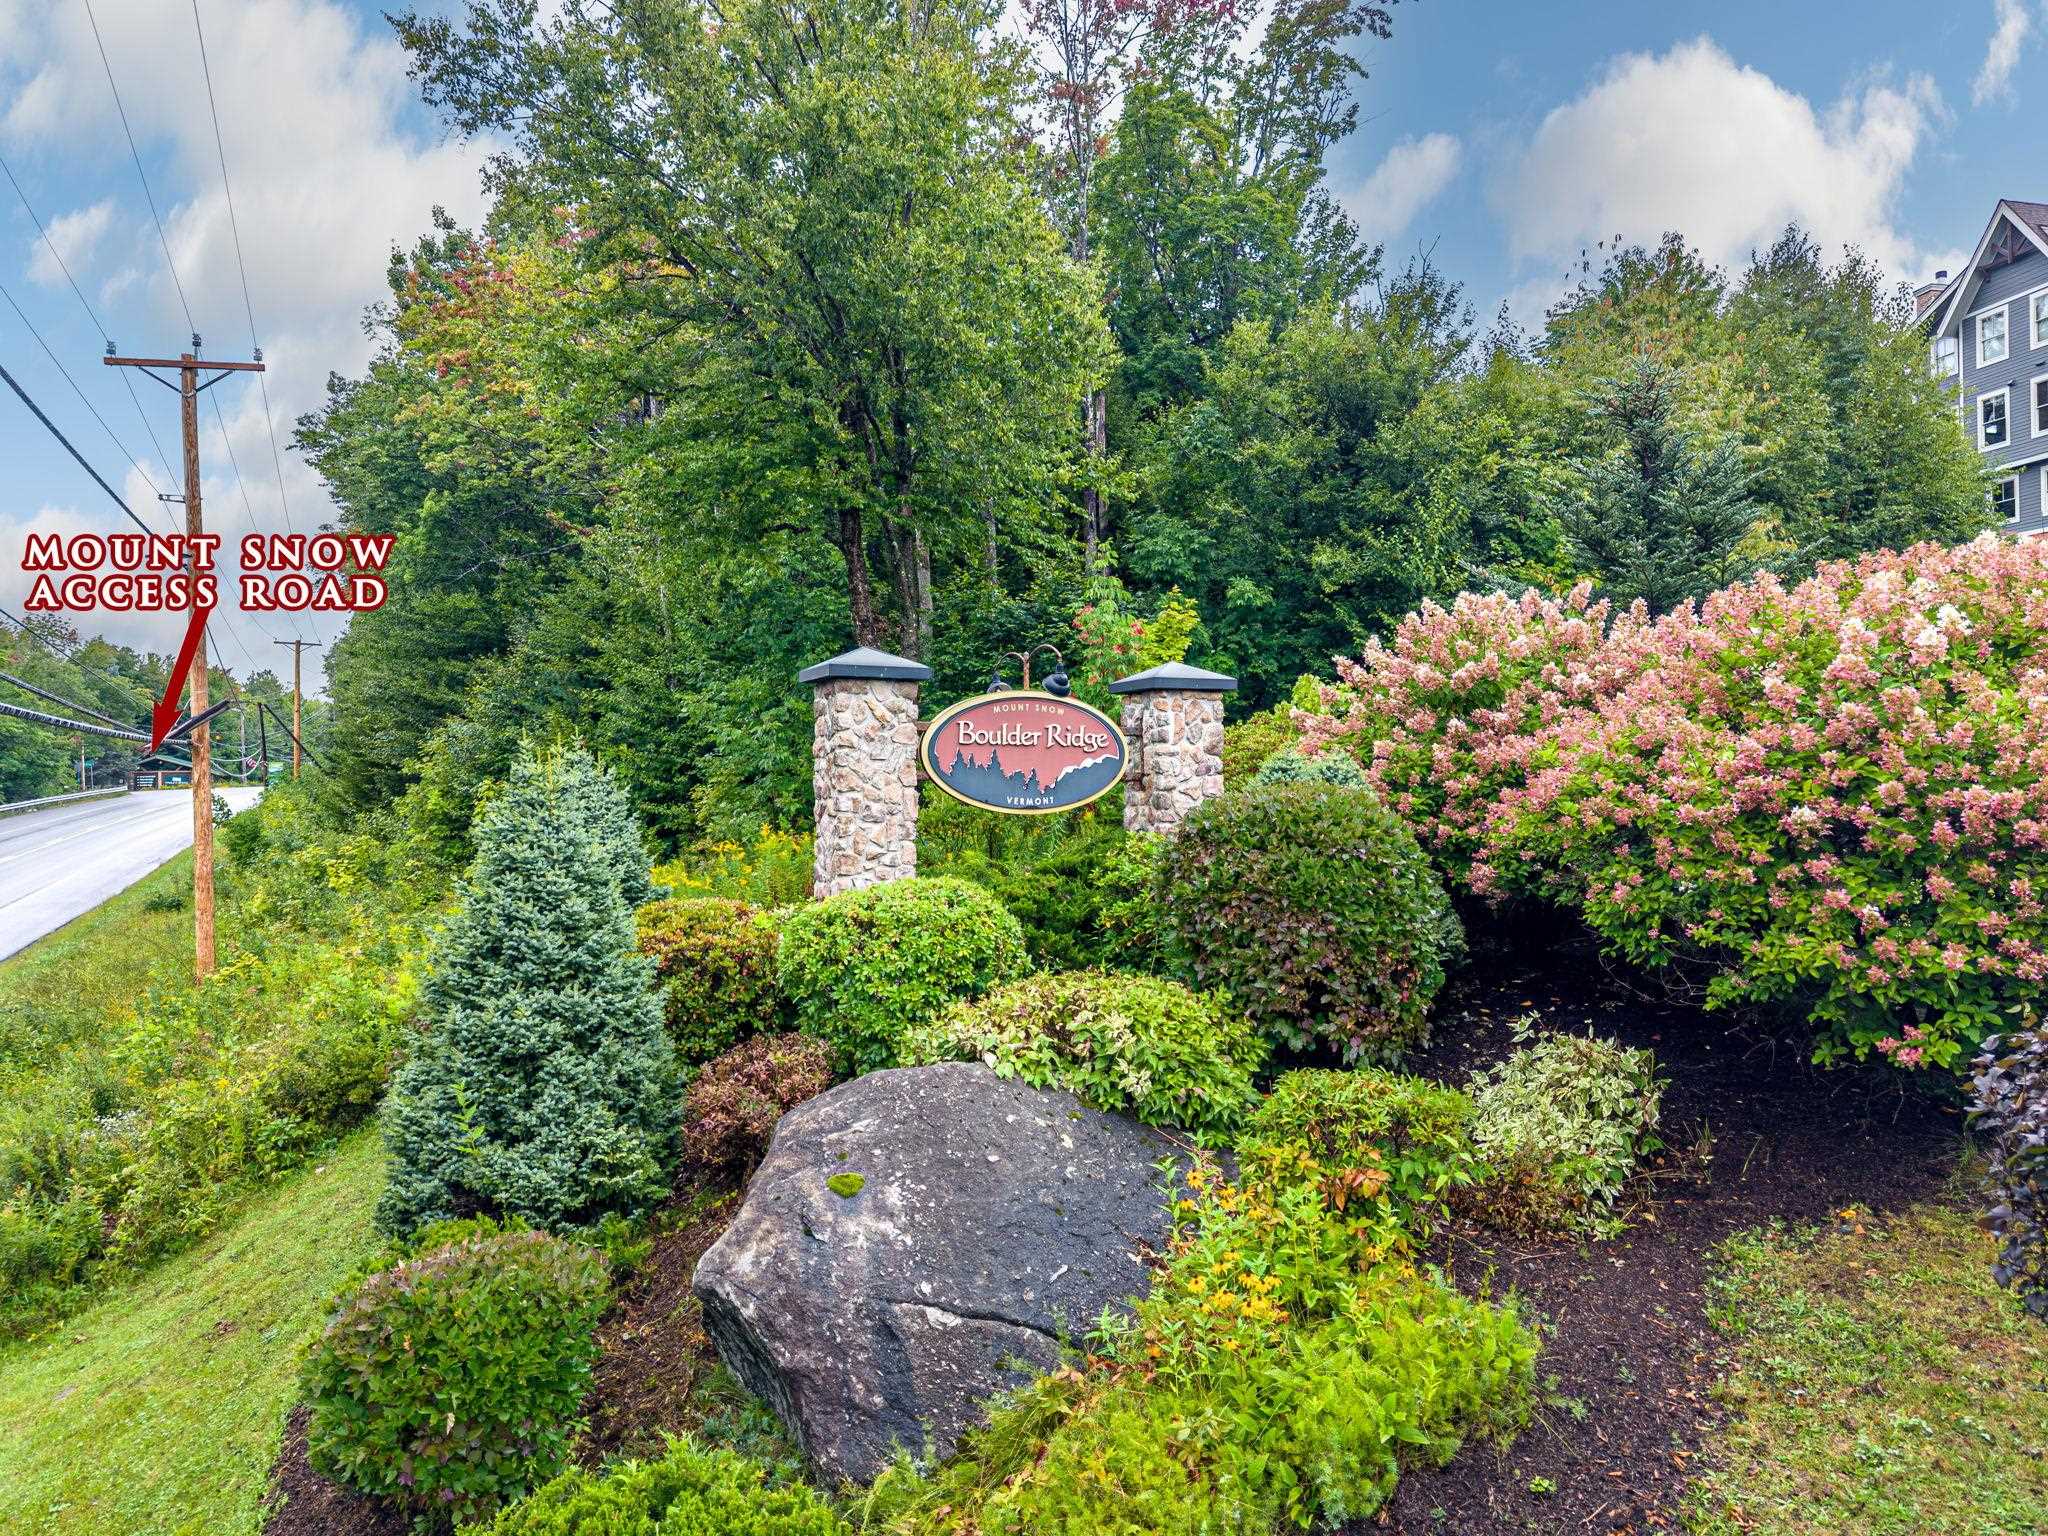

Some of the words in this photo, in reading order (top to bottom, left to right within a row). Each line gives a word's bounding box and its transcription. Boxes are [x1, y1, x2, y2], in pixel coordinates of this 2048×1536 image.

[993, 703, 1030, 714] MOUNT
[1035, 703, 1065, 715] SNOW
[957, 720, 1041, 746] Boulder
[1046, 724, 1109, 752] Ridge
[1006, 796, 1054, 806] VERMONT
